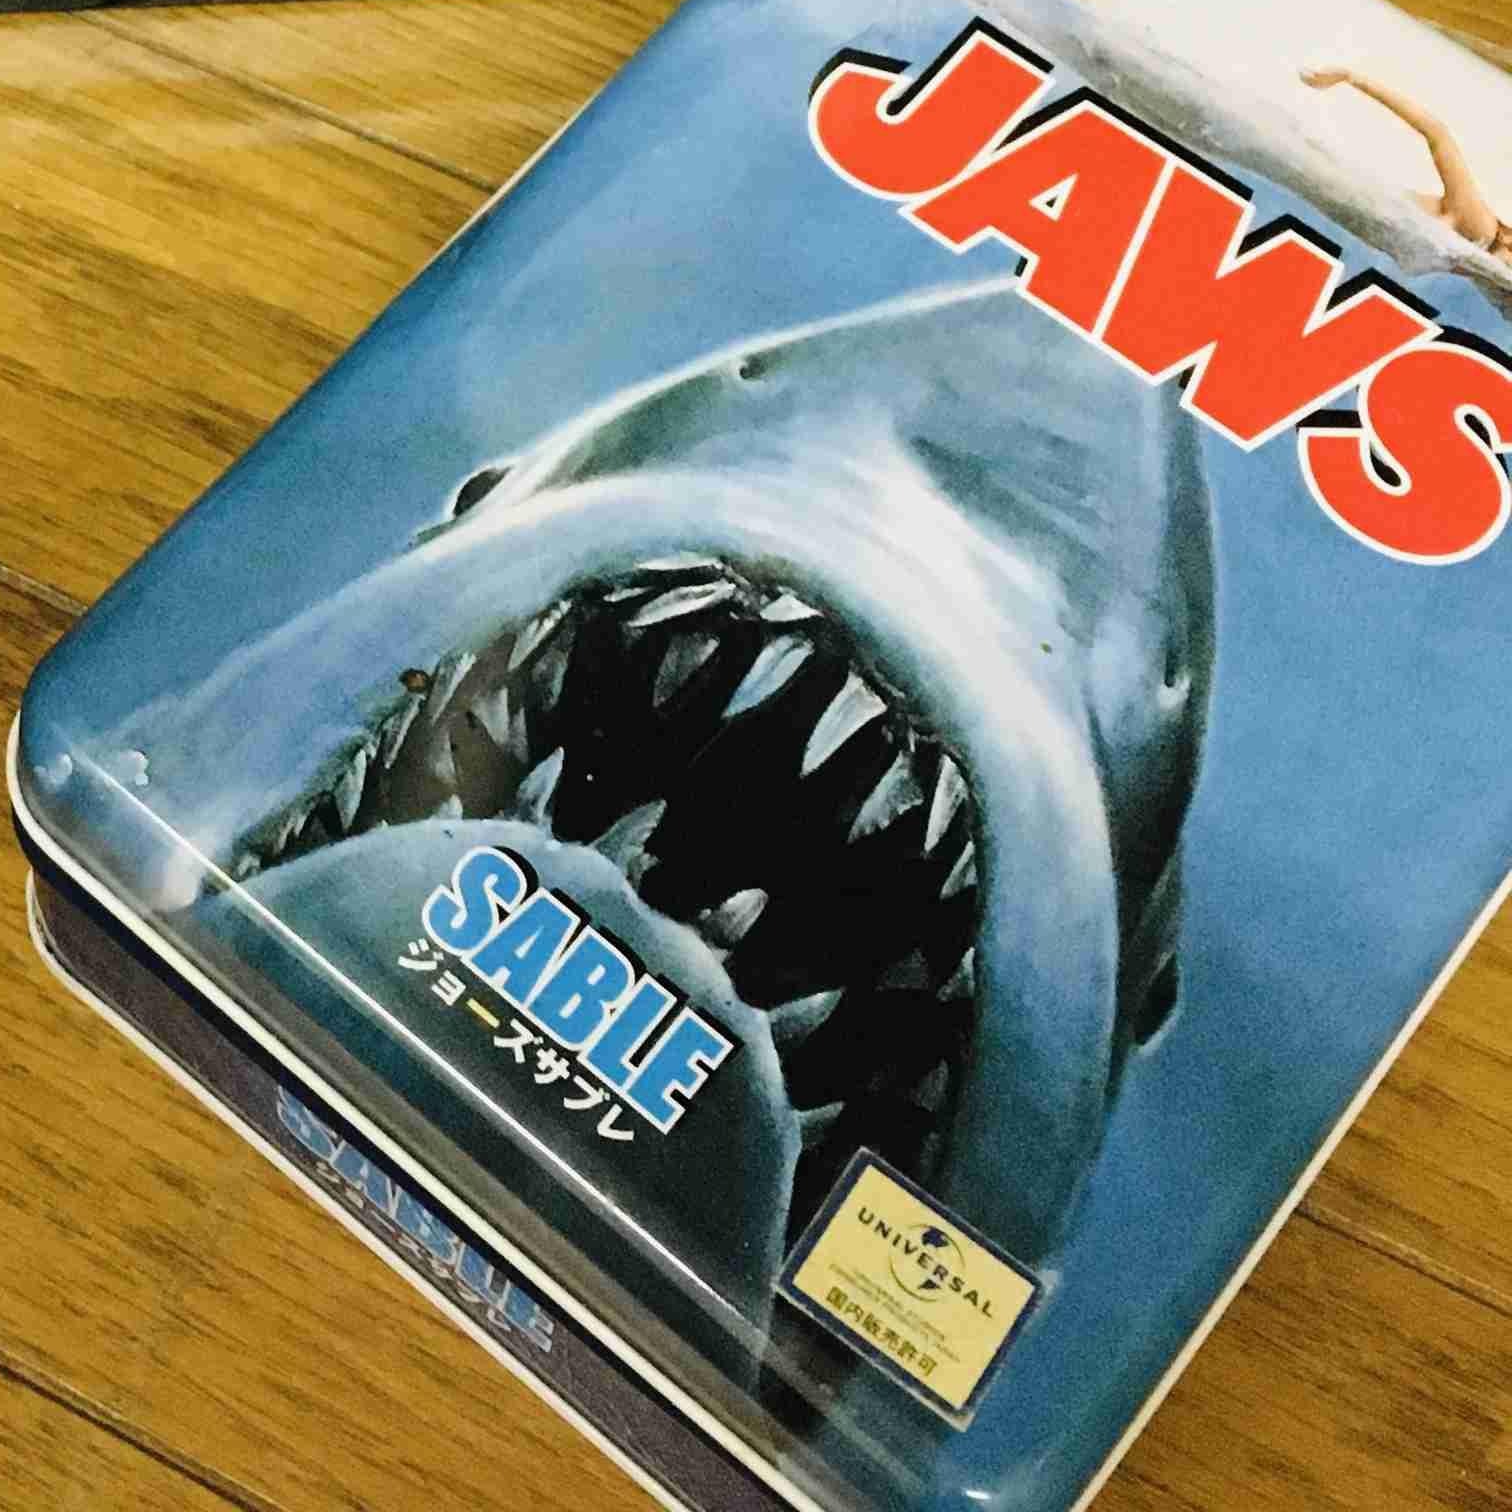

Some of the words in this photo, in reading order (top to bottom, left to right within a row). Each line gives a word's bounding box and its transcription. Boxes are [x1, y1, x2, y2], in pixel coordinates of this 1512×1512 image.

[807, 18, 1512, 566] JAWS
[396, 937, 637, 1144] ジョーズサブレ
[420, 844, 738, 1136] SABLE
[856, 1206, 996, 1320] UNIVERSAL
